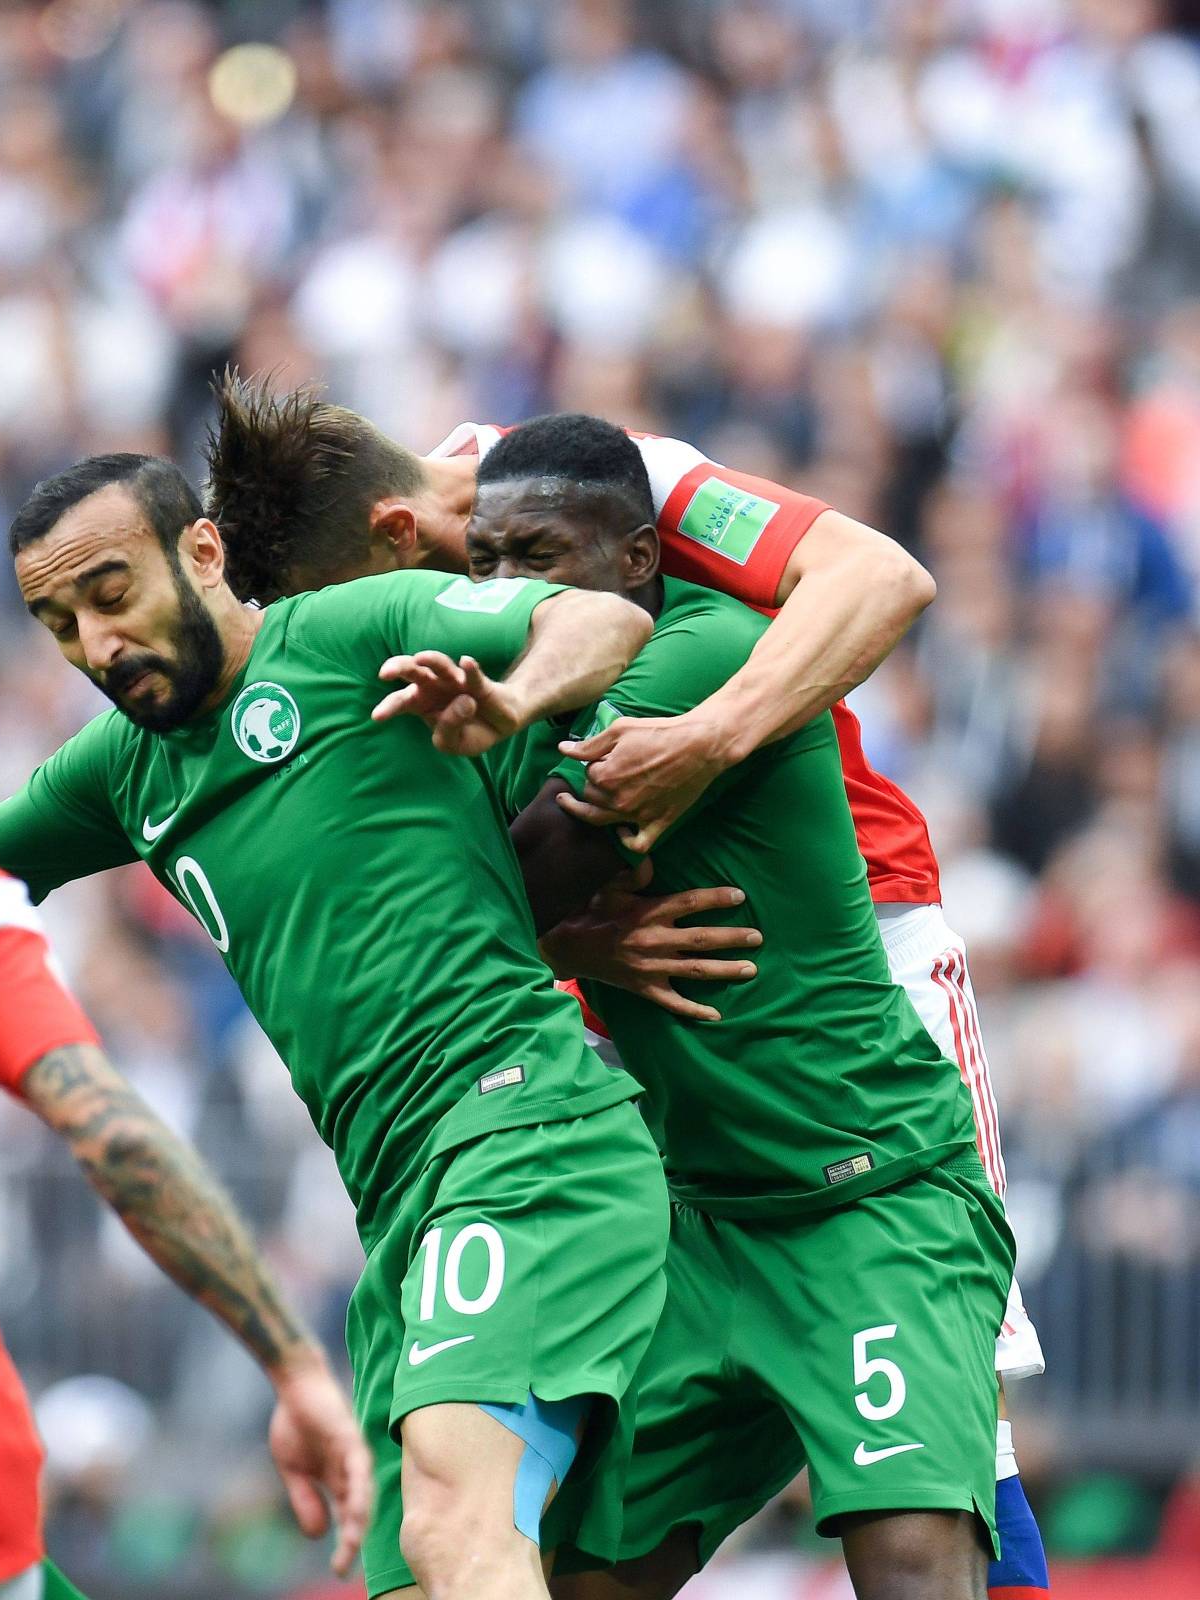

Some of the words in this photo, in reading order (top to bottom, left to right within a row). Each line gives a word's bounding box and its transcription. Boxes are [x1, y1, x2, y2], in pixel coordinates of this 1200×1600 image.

[272, 718, 290, 735] SAFF
[419, 1222, 505, 1320] 10
[853, 1324, 906, 1421] 5
